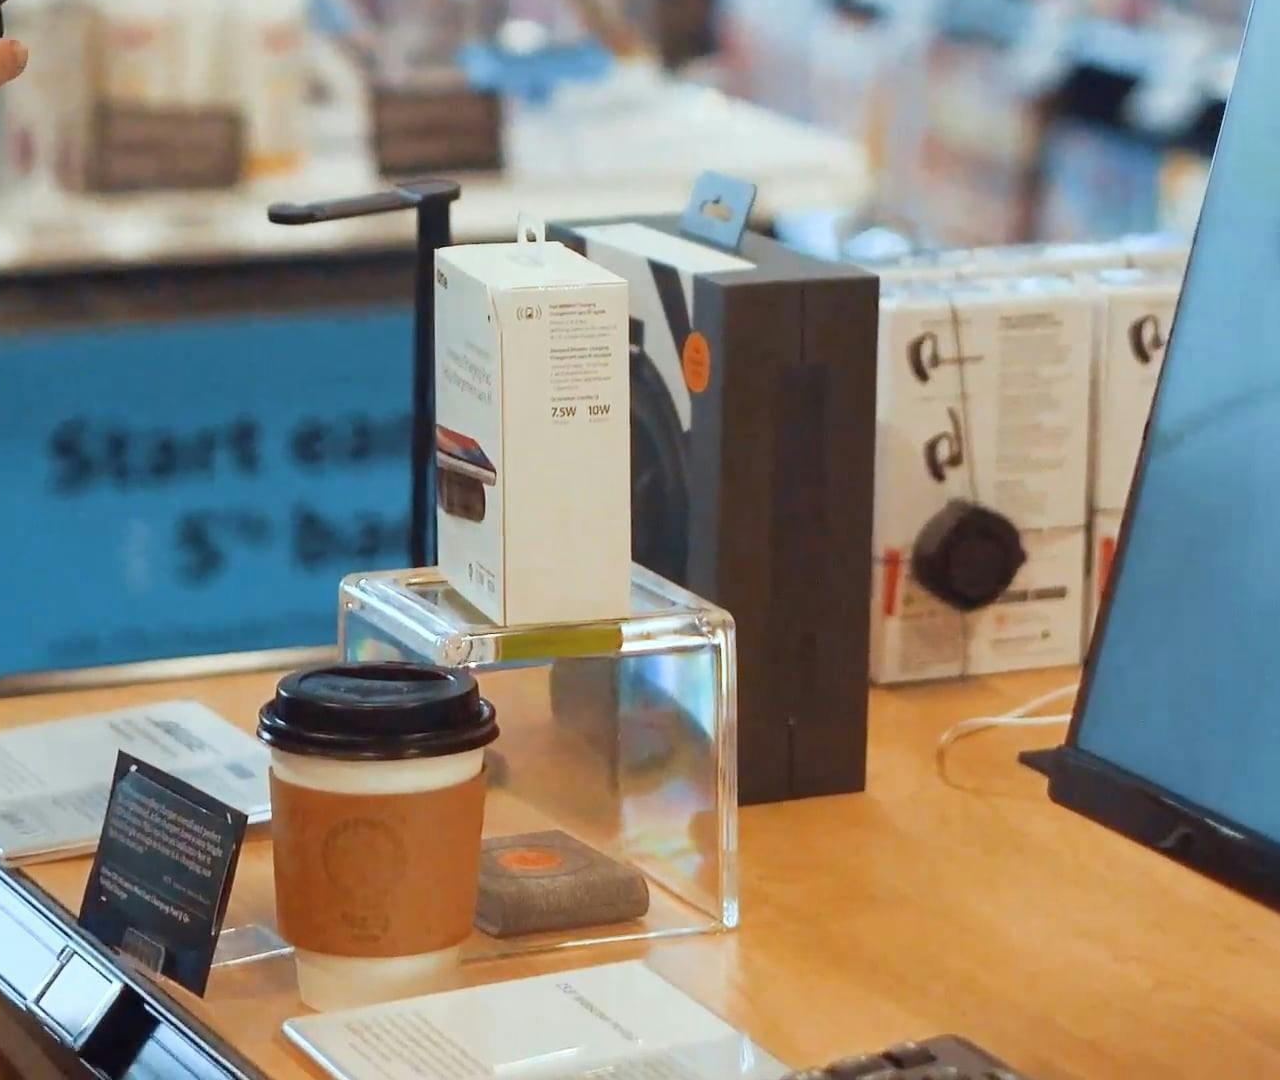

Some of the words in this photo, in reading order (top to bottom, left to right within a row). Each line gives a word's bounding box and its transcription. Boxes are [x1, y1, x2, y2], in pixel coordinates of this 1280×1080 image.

[551, 405, 577, 418] 7.5W
[588, 403, 611, 416] 10W
[48, 416, 261, 499] Start
[289, 418, 412, 474] ear
